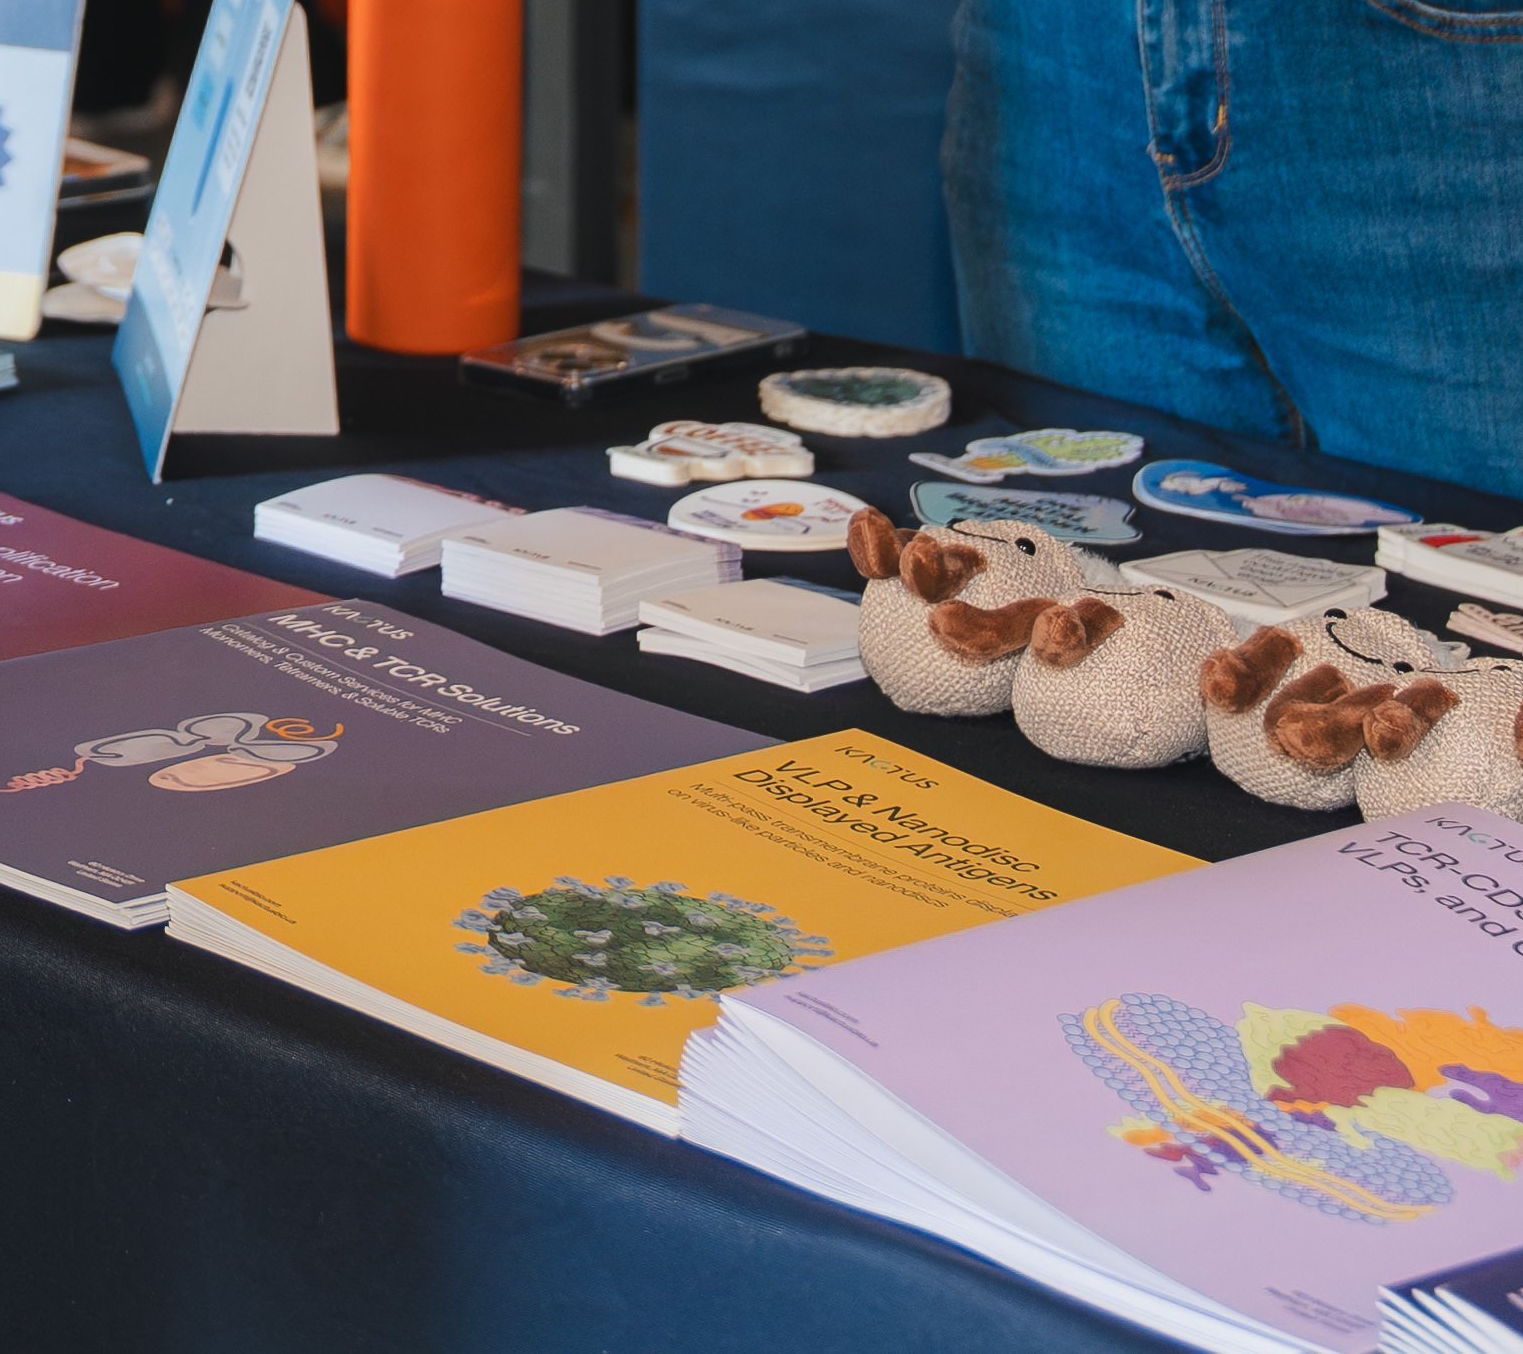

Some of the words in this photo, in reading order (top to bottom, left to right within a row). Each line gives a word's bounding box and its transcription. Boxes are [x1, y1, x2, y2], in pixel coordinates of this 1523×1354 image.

[220, 621, 275, 651] Catalog
[285, 650, 341, 681] Custom
[337, 674, 403, 705] Services
[265, 612, 357, 649] MHC
[343, 645, 381, 662] &
[372, 655, 448, 689] TCR
[437, 683, 582, 737] Solutions
[321, 603, 416, 642] KACTUS
[773, 759, 855, 794] VLP
[842, 792, 881, 809] &
[871, 805, 1043, 875] Nanodisc
[834, 745, 940, 791] KACTUS
[666, 787, 690, 800] on
[690, 796, 759, 836] virus-like
[754, 830, 833, 867] particles
[826, 859, 863, 878] and
[860, 874, 953, 911] nanodiscs
[689, 781, 773, 824] Multi-pass
[770, 819, 900, 877] transmembrane
[892, 871, 969, 903] proteins
[963, 895, 1020, 920] displa
[732, 768, 911, 845] Displayed
[894, 841, 1059, 903] Antigens
[1335, 839, 1433, 895] VLPs,
[1434, 890, 1519, 940] and
